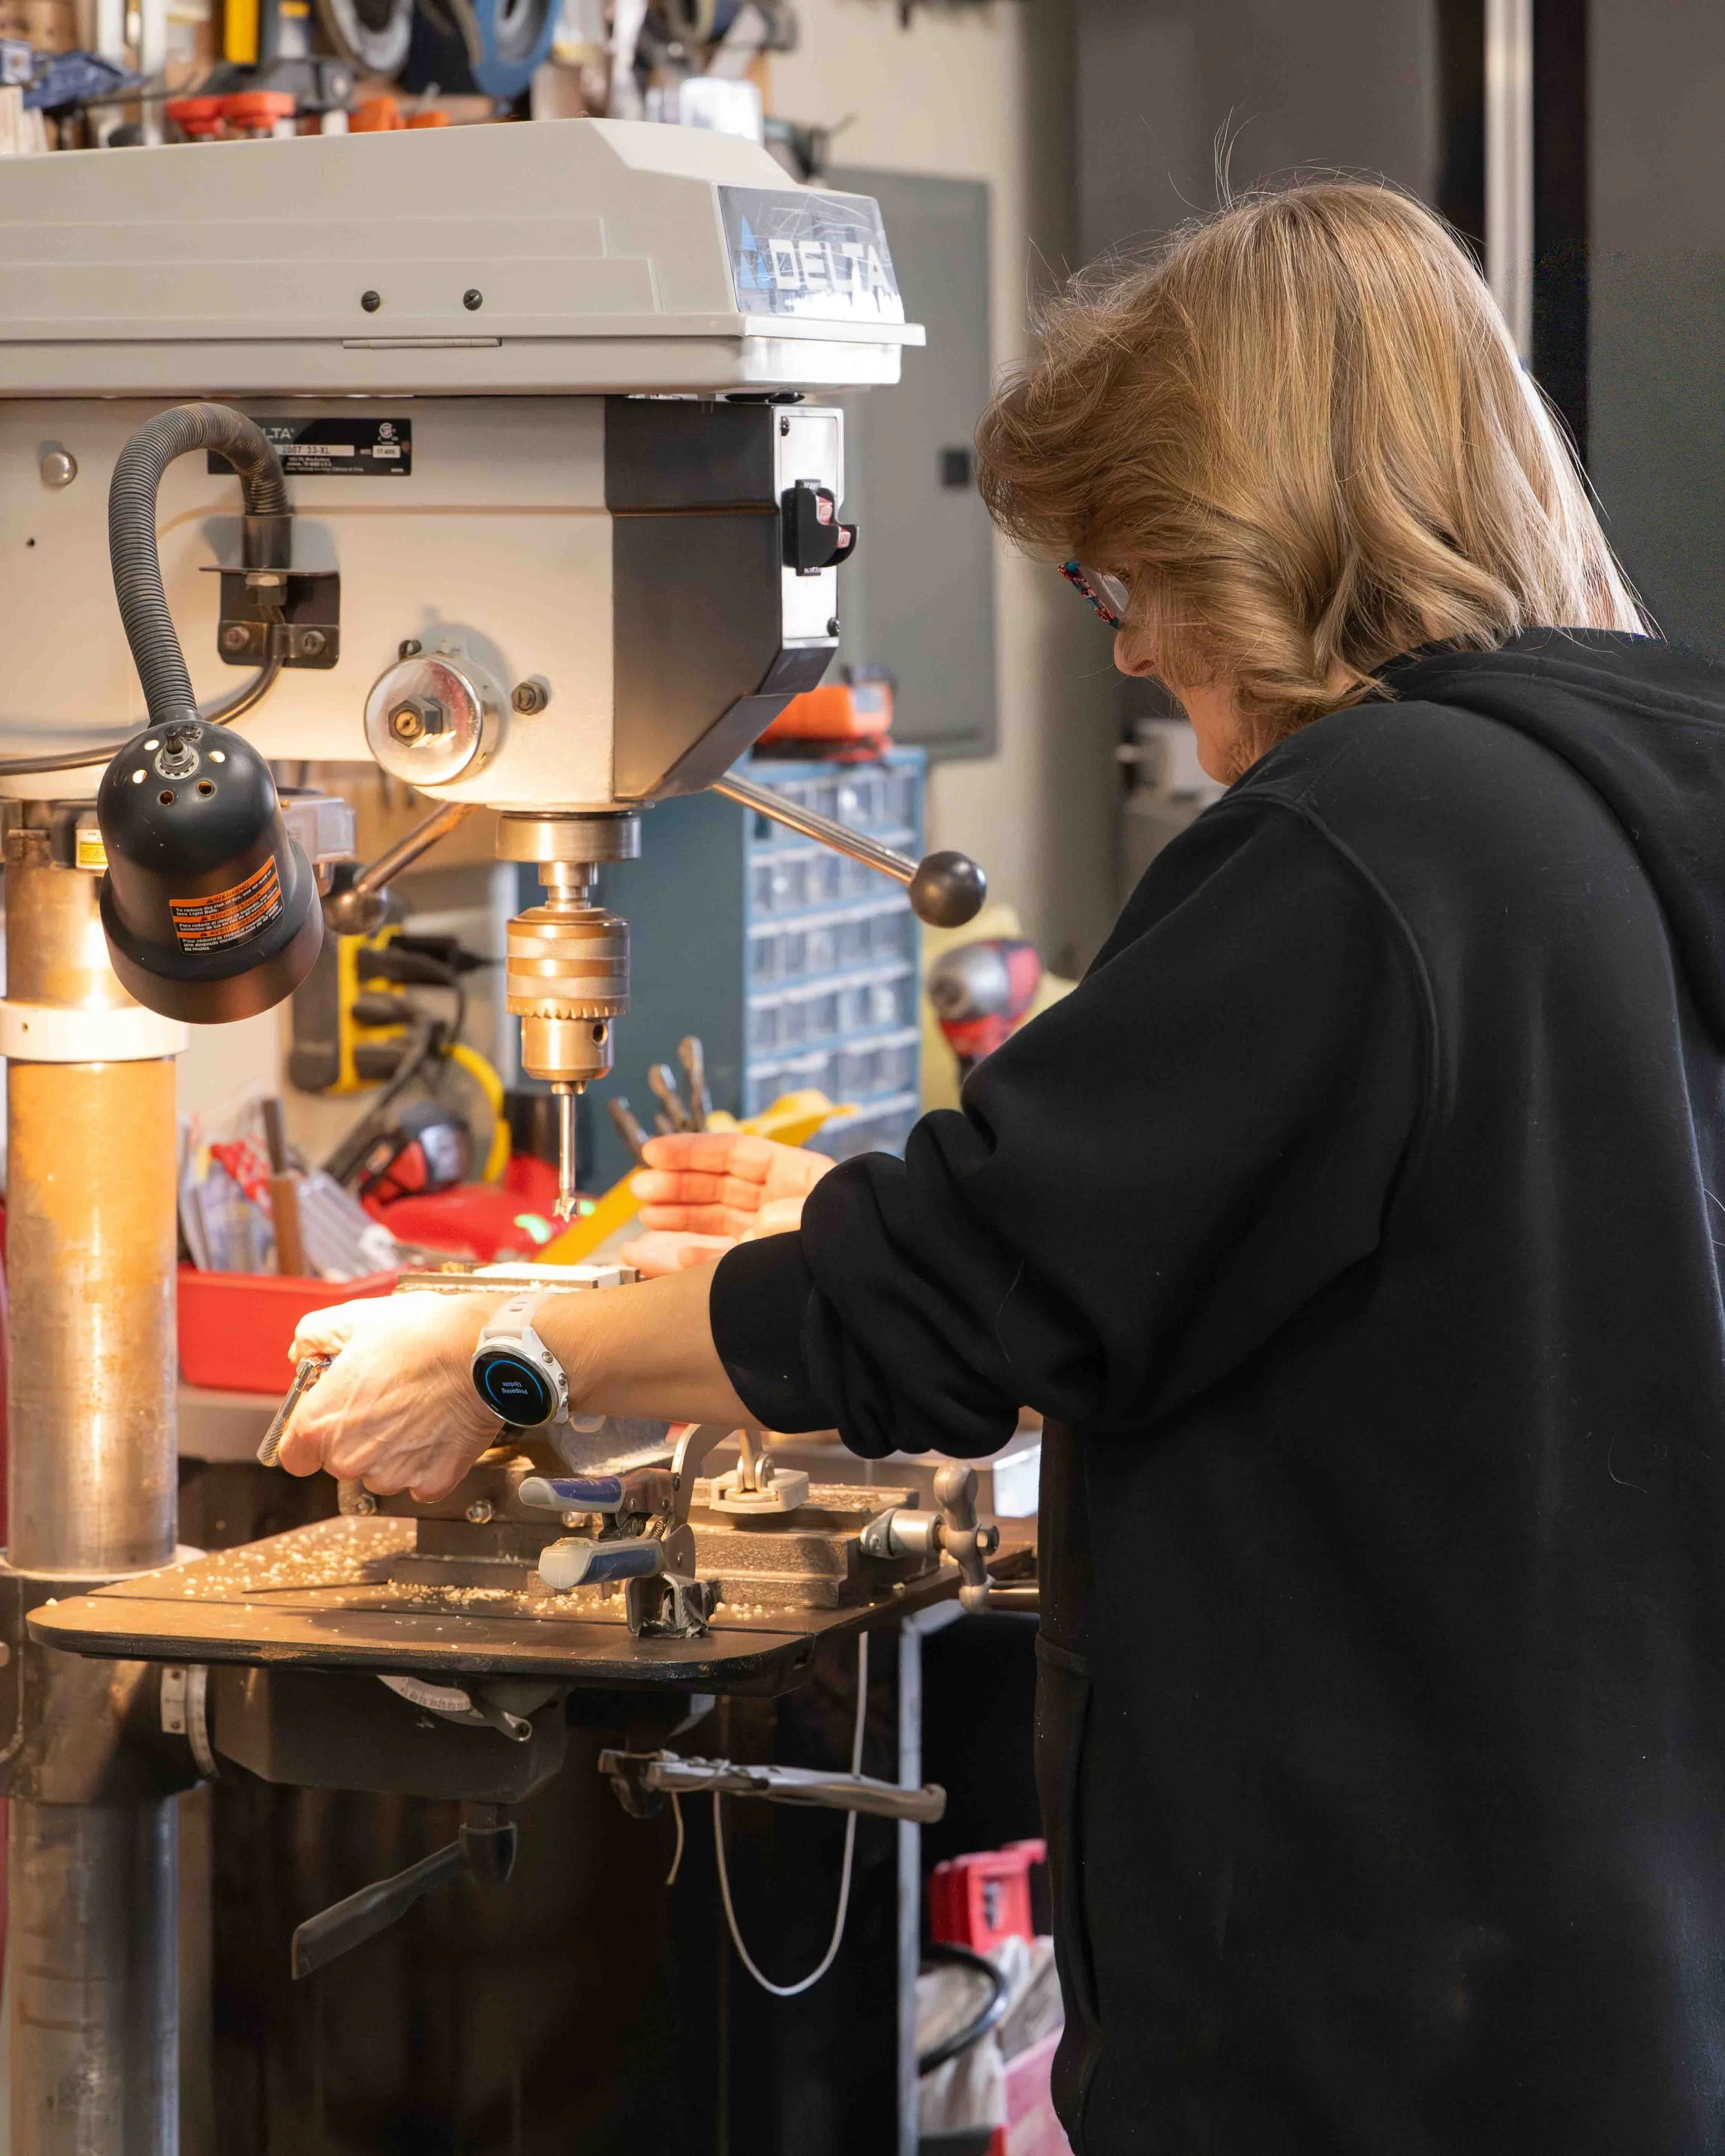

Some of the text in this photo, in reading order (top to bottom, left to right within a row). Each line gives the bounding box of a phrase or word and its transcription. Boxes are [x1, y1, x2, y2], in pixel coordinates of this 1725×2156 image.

[769, 239, 889, 291] DELTA
[210, 893, 261, 920] ADVERTENCIA
[213, 884, 250, 902] WARNING
